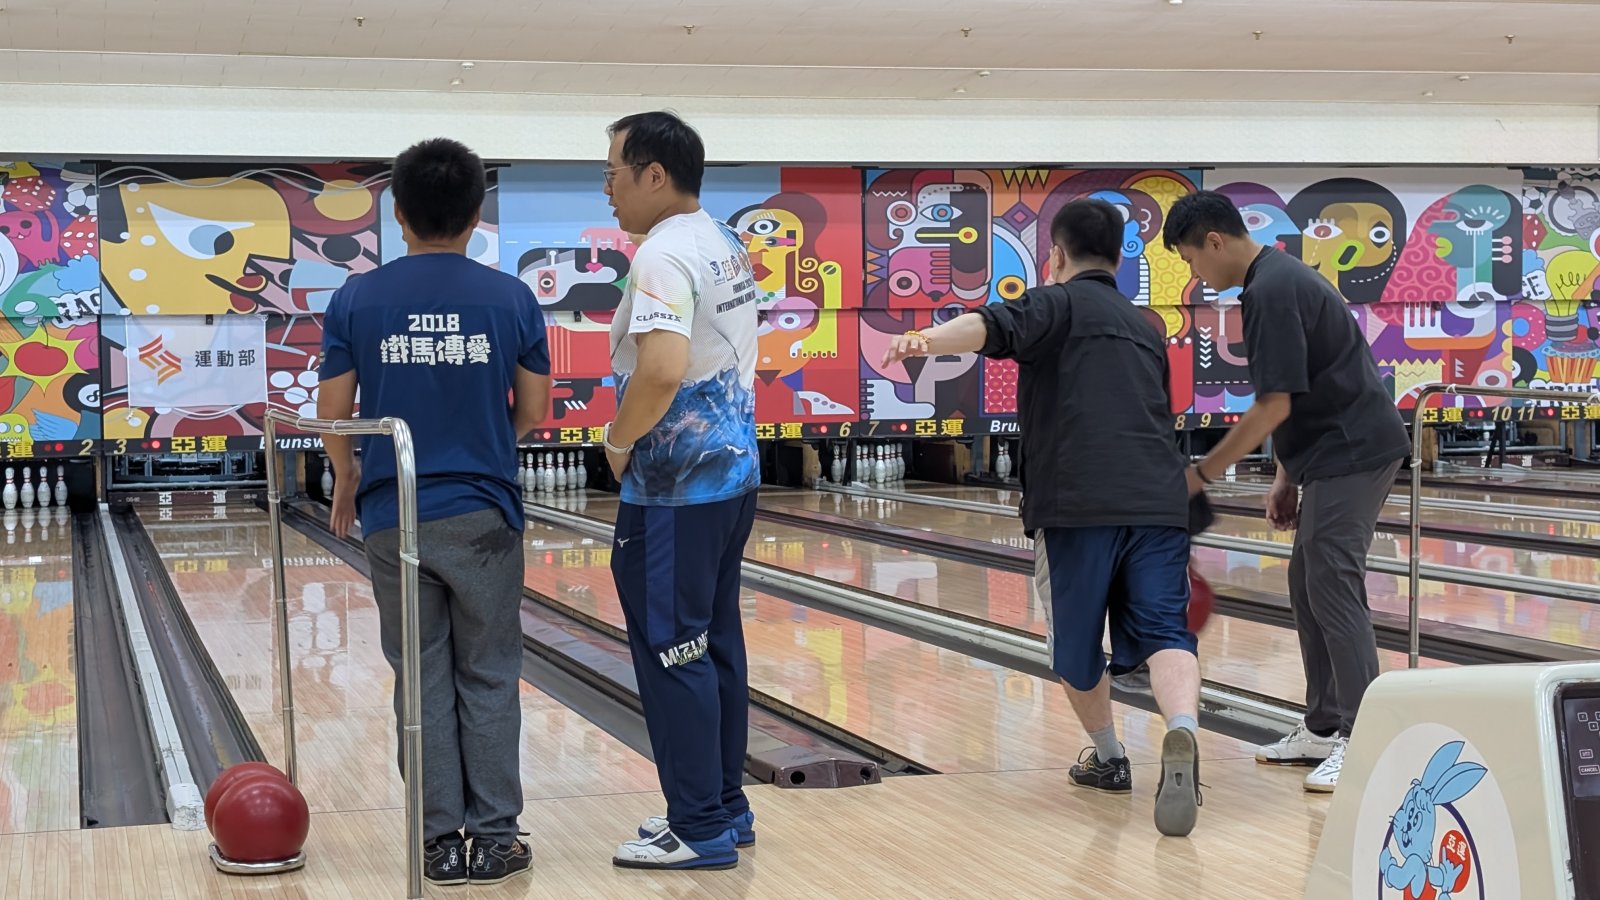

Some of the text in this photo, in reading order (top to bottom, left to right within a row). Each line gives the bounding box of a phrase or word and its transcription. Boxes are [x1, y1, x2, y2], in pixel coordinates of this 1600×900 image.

[408, 313, 460, 332] 2018
[380, 333, 491, 366] 鐵馬傳愛
[195, 349, 256, 368] 運動部
[1200, 412, 1212, 427] 9
[1423, 407, 1463, 423] 亞運
[1491, 406, 1512, 421] 10
[1517, 406, 1535, 420] 11
[755, 422, 803, 439] 亞運
[839, 421, 852, 437] 6
[868, 420, 880, 436] 7
[915, 419, 964, 436] 亞運
[990, 420, 1020, 433] Bru
[1174, 415, 1186, 430] 8
[79, 439, 94, 455] 2
[114, 439, 127, 454] 3
[171, 435, 228, 454] 亞運
